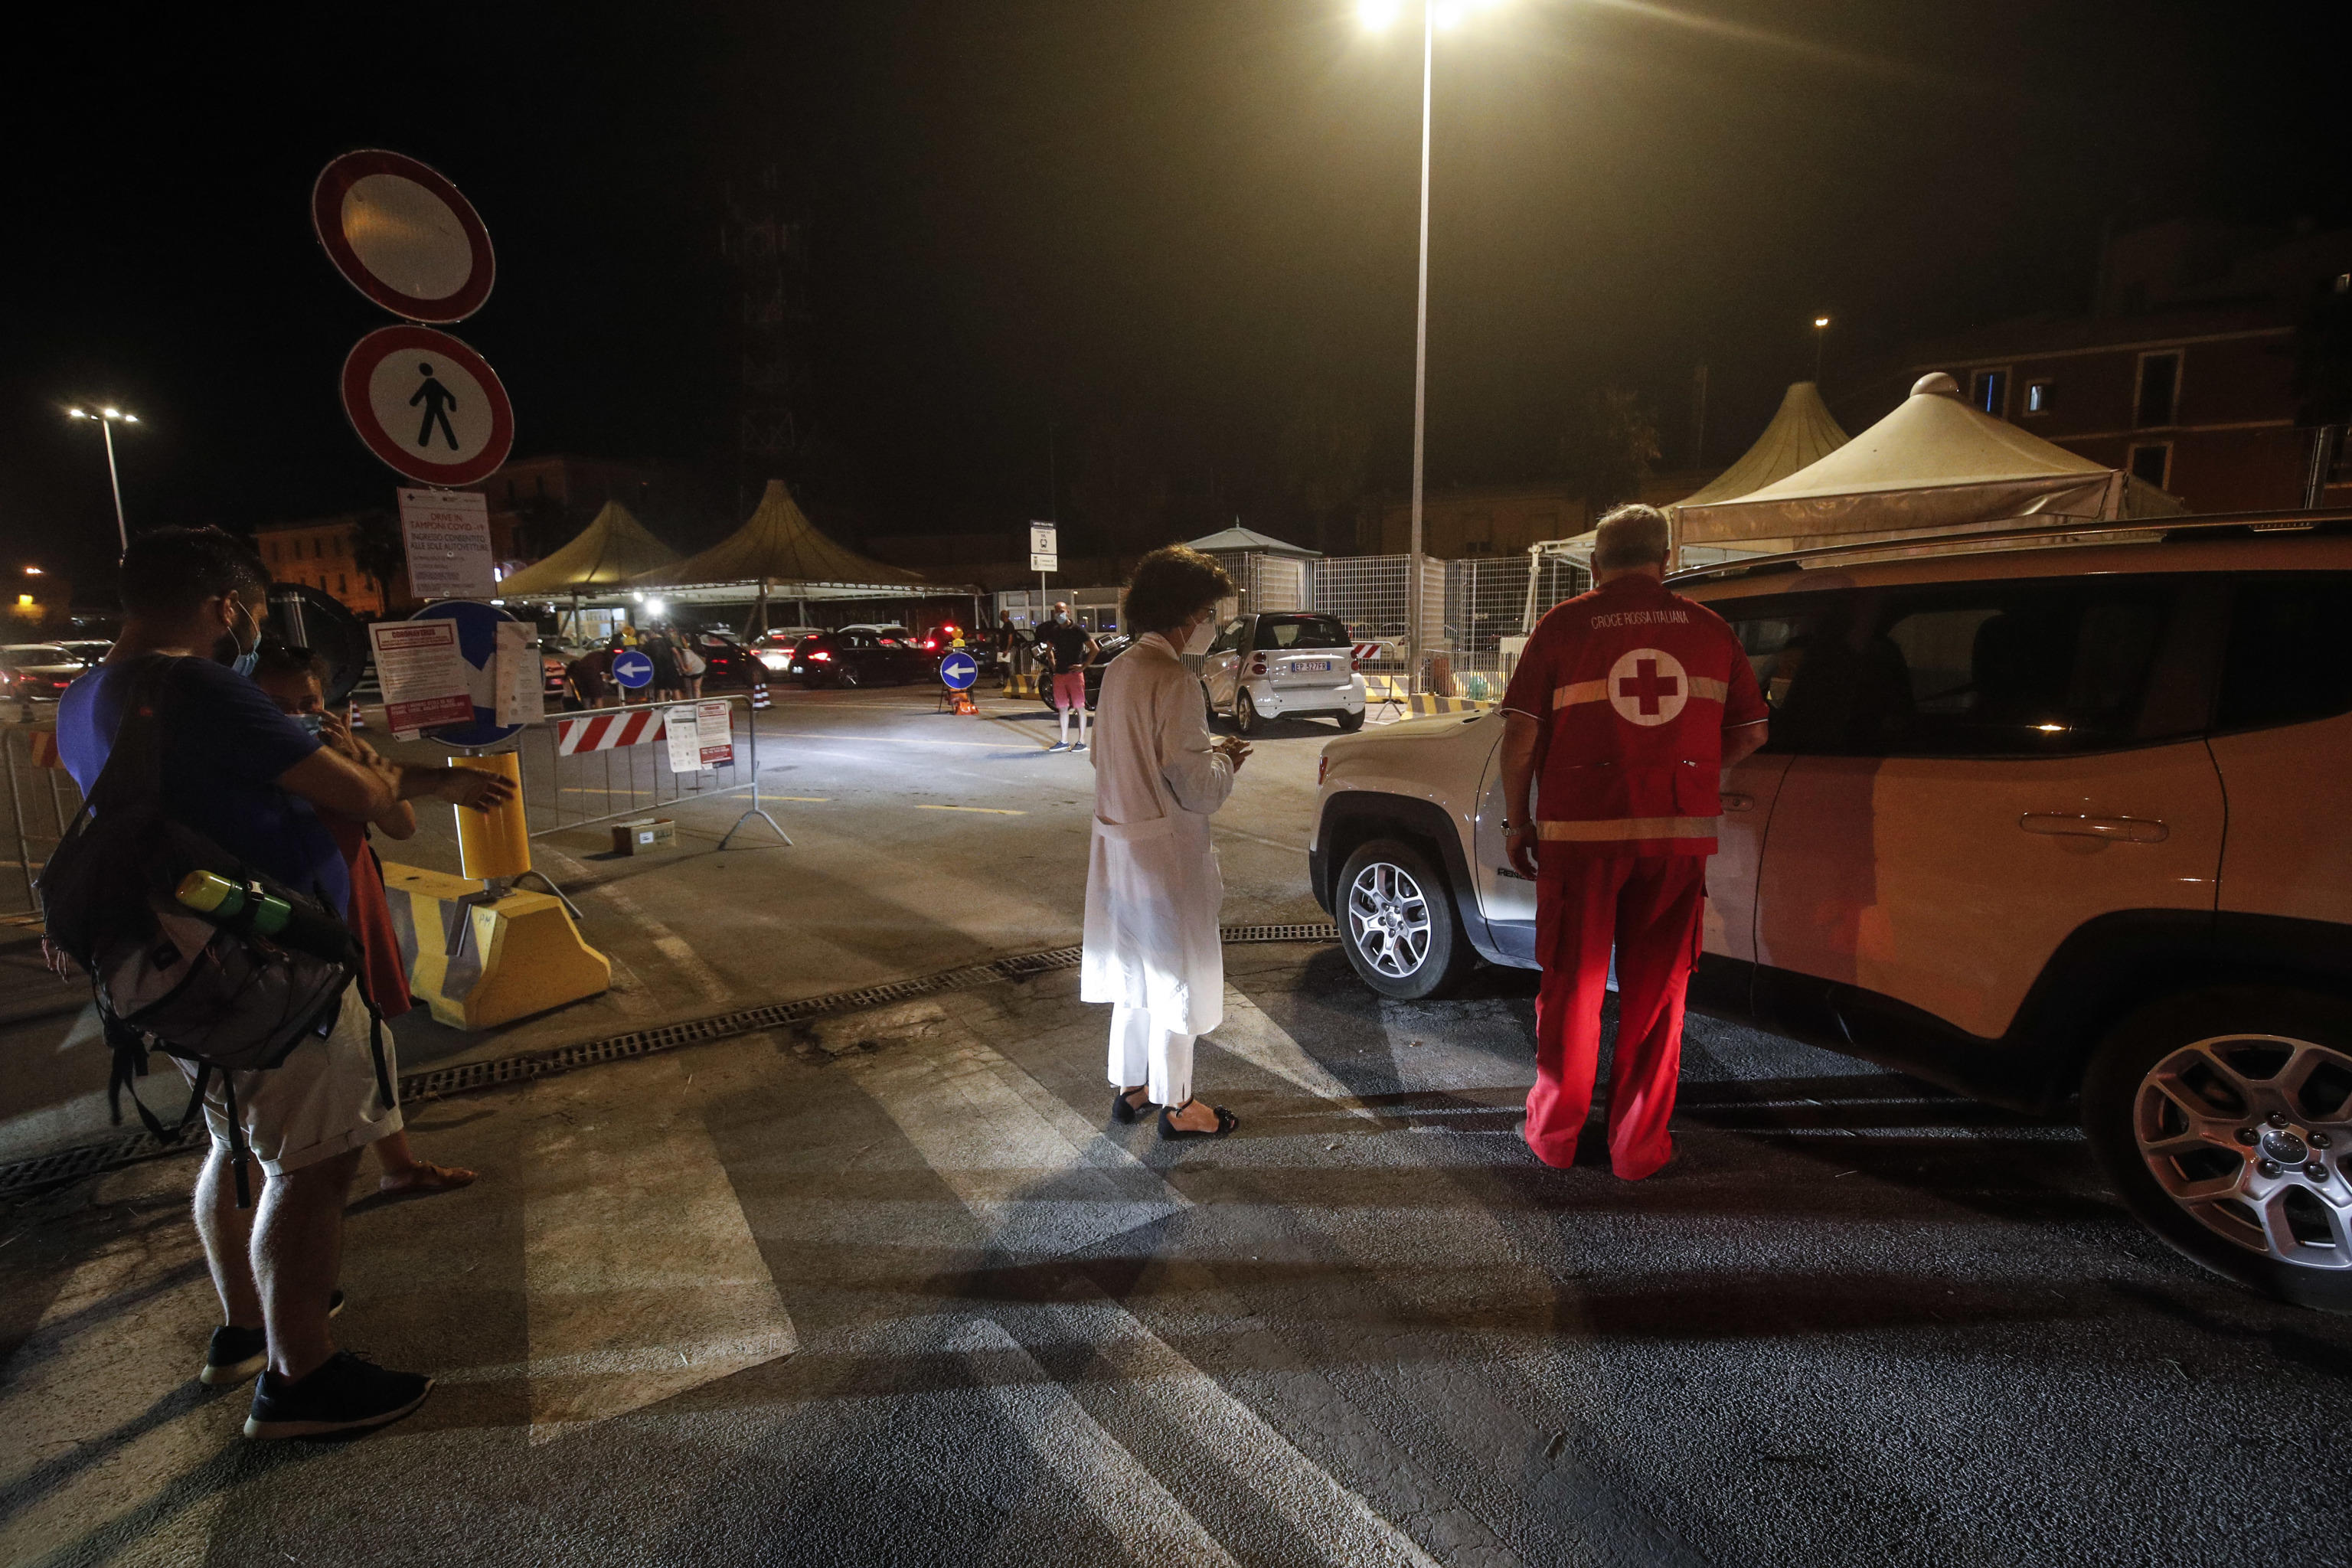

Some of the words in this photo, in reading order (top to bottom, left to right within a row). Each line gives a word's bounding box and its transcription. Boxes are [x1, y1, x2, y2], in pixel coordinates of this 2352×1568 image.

[430, 513, 452, 521] DRIVE
[410, 521, 446, 530] TAMPONI
[411, 542, 425, 550] ALLE
[1591, 613, 1623, 629] CROCE
[1624, 611, 1652, 625] ROSSA
[1652, 610, 1689, 624] ITALIANA
[391, 628, 436, 639] CORONAVIRUS
